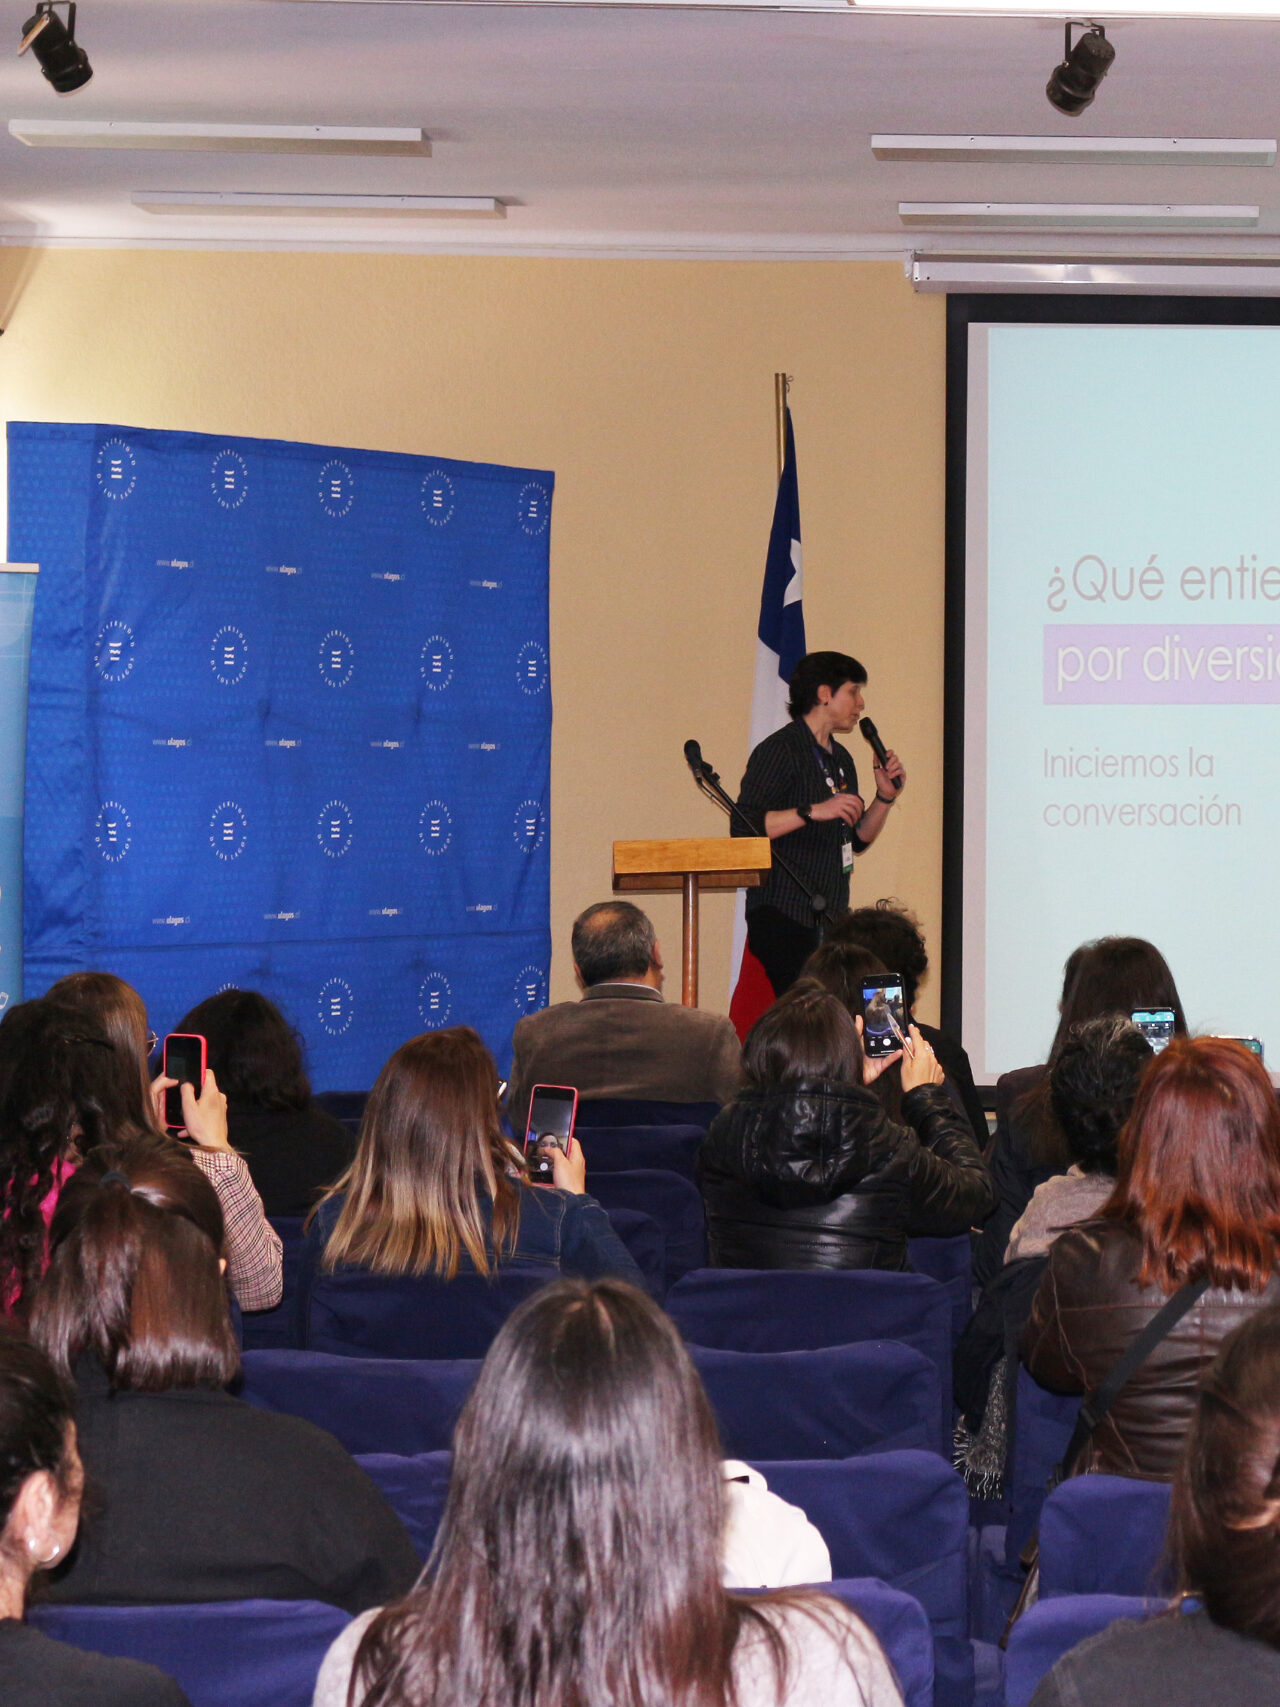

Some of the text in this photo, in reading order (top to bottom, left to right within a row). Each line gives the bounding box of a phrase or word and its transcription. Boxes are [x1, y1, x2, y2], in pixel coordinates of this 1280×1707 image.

[1047, 554, 1165, 612] ¿Qué
[1057, 646, 1130, 691] por
[1044, 747, 1214, 778] Iniciemos la
[1043, 794, 1241, 827] conversación
